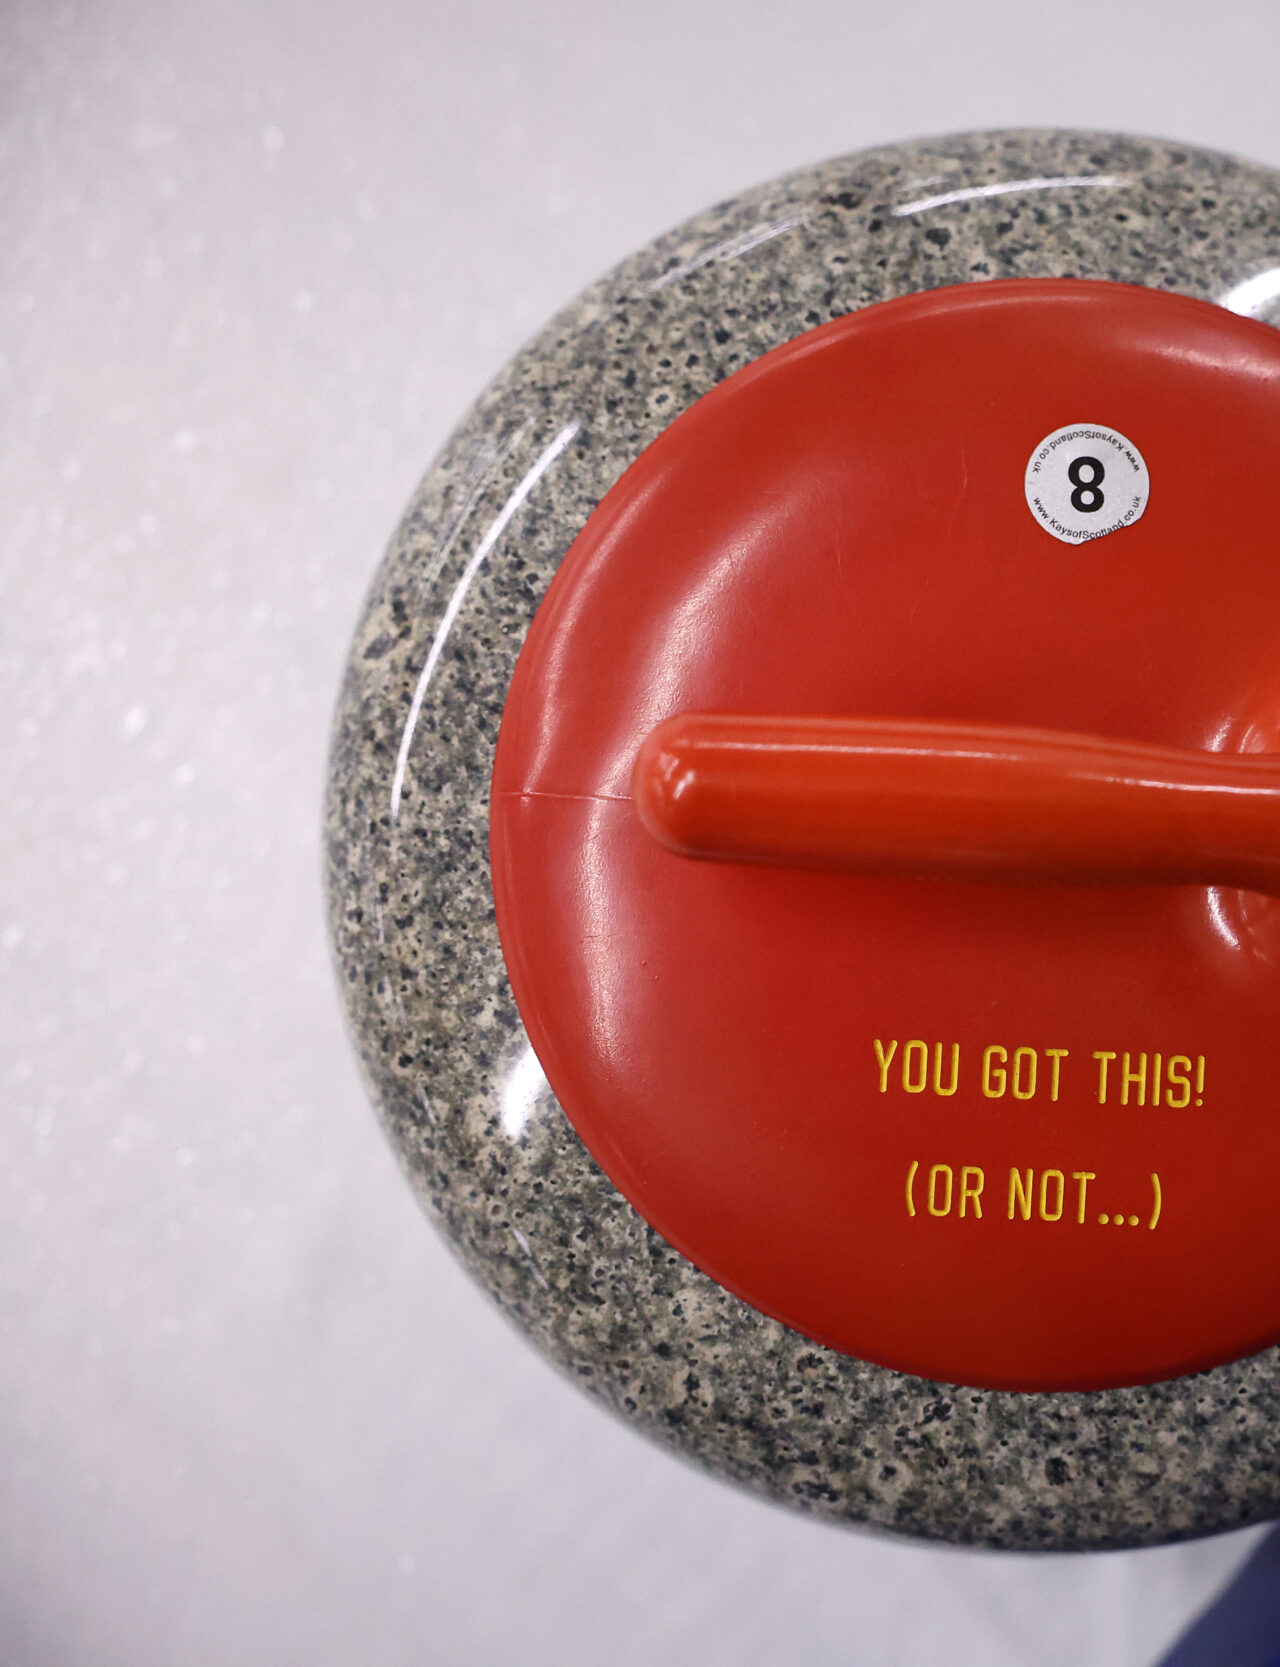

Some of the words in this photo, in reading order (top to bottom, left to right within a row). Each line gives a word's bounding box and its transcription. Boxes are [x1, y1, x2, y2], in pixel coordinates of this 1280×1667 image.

[1032, 430, 1140, 474] www.KaysofScotland.co.uk
[1068, 456, 1105, 513] 8
[1033, 496, 1141, 539] www.KaysofScotland.co.uk
[873, 1038, 960, 1096] YOU
[982, 1045, 1069, 1102] GOT
[1092, 1051, 1206, 1108] THIS!
[905, 1160, 985, 1219] (OR
[1007, 1167, 1162, 1230] NOT...)
